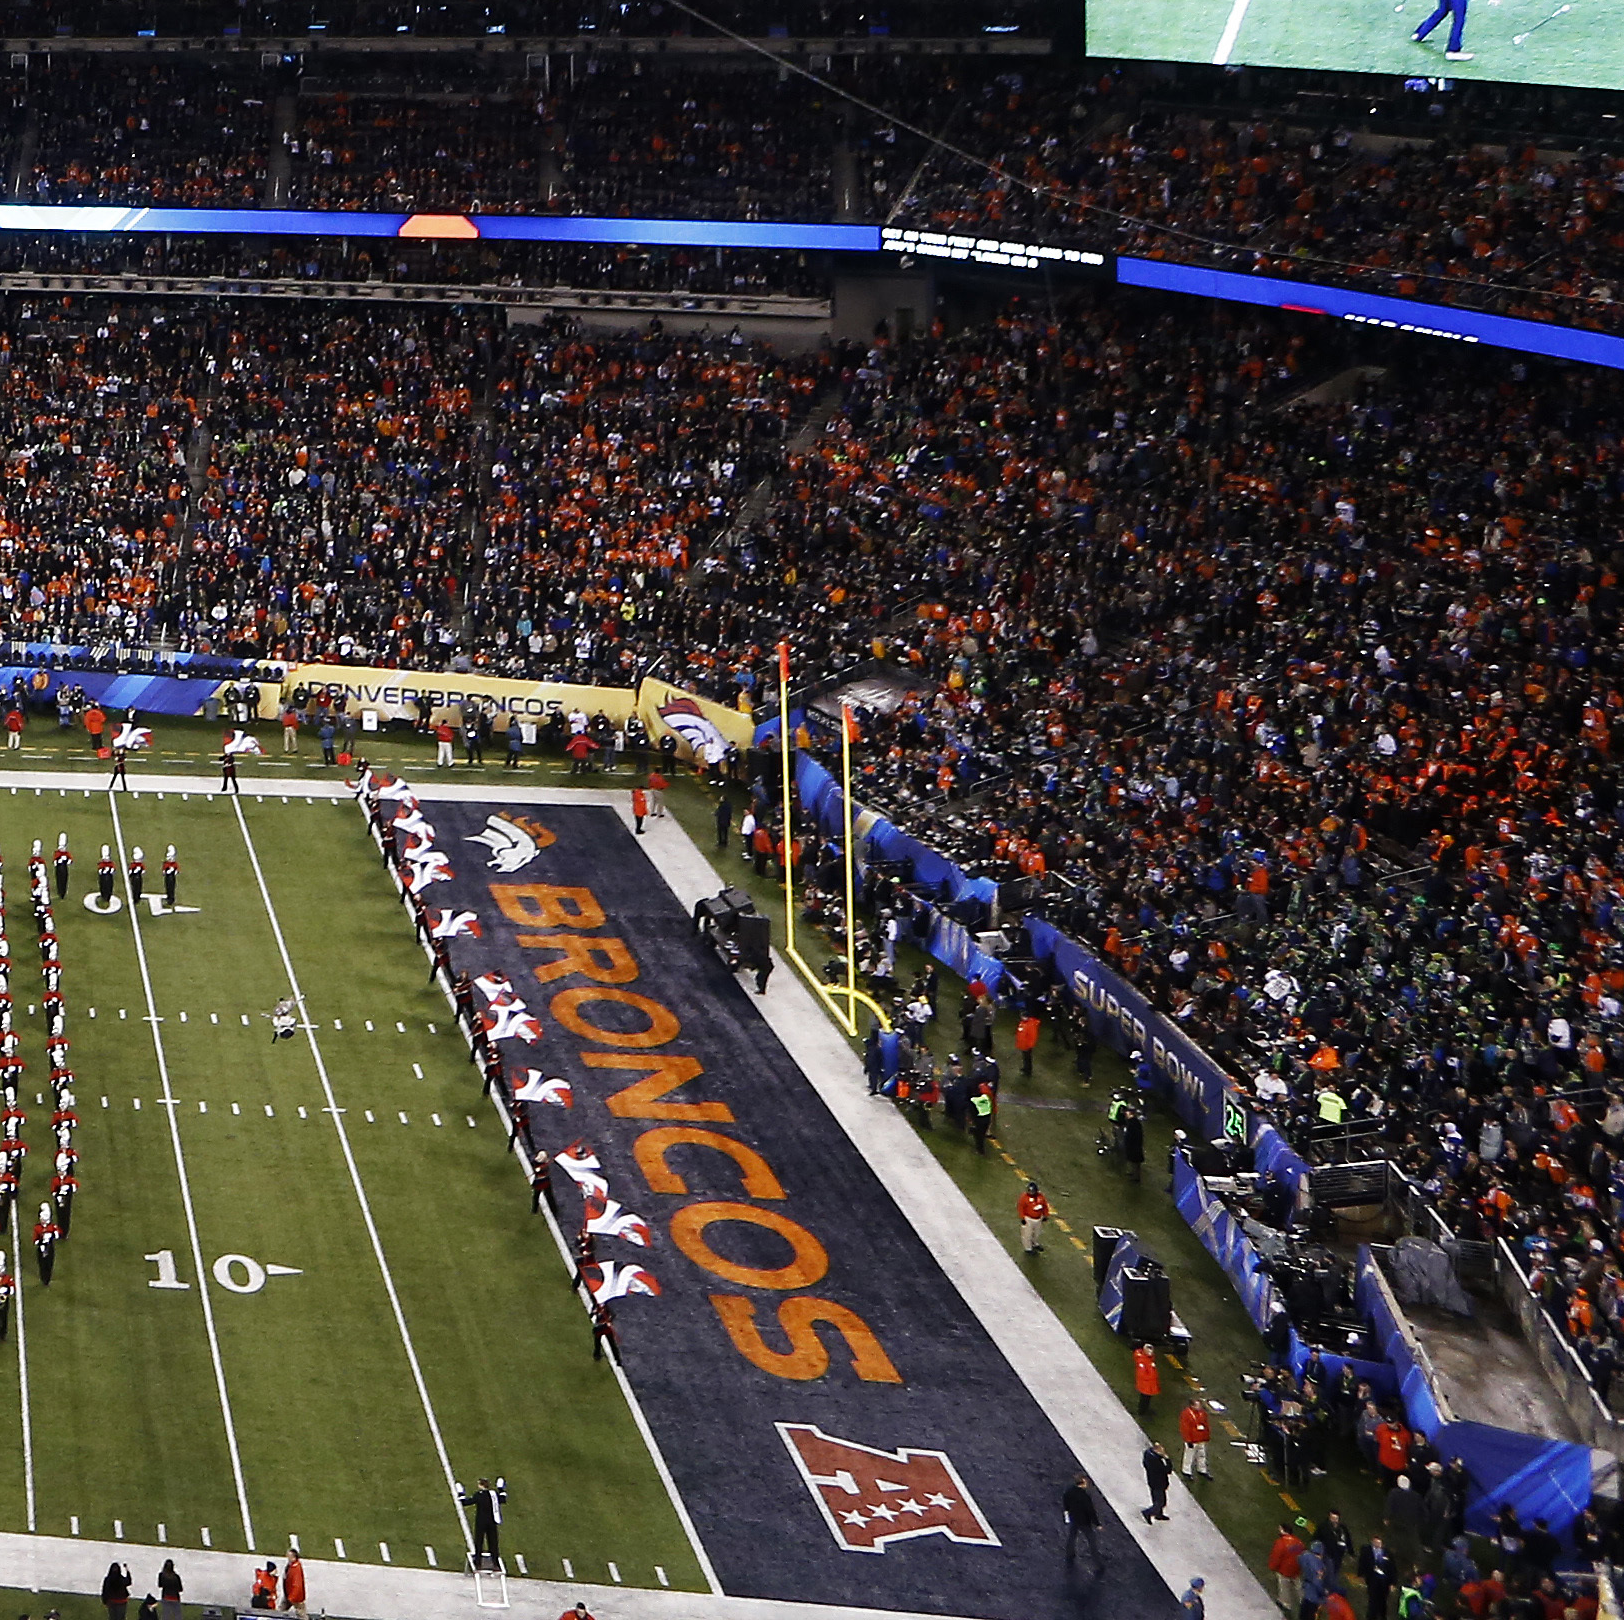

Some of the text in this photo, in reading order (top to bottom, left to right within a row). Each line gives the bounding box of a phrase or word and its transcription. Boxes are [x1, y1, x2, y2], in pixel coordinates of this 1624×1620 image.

[1072, 968, 1211, 1114] SUPER BOWL
[489, 883, 903, 1386] BRONCOS
[1224, 1102, 1245, 1137] 25
[144, 1248, 267, 1295] 10
